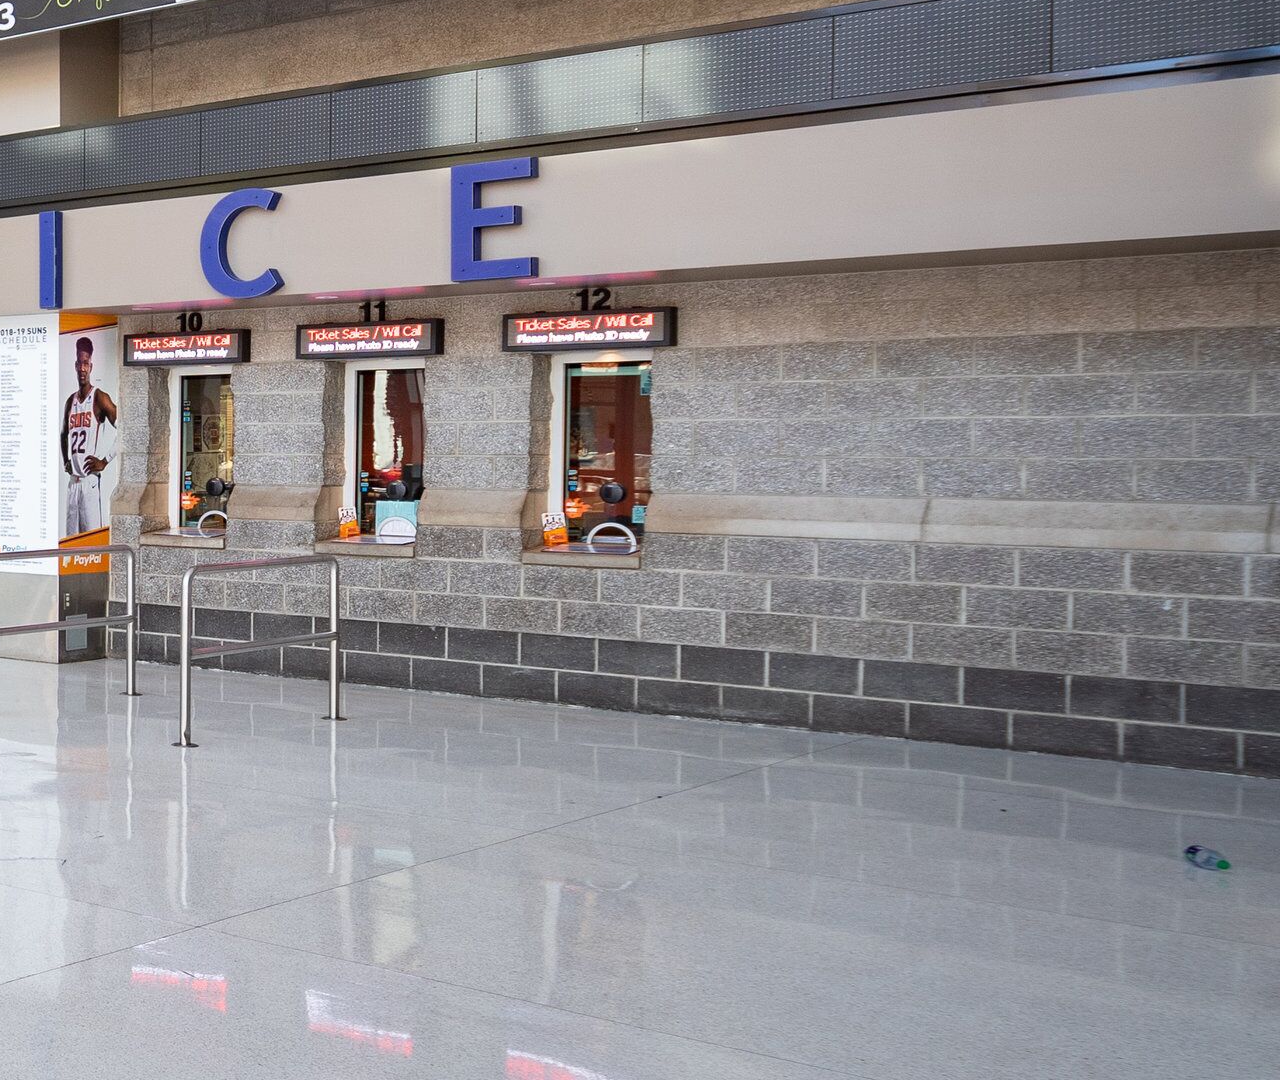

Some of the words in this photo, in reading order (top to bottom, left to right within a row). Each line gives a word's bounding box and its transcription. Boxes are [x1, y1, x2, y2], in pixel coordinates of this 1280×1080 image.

[576, 288, 612, 312] 12
[358, 300, 386, 322] 11
[27, 326, 48, 335] SUNS
[176, 311, 203, 333] 10
[516, 320, 554, 332] Ticket
[557, 317, 591, 330] Sales
[604, 314, 627, 327] Will
[630, 313, 654, 327] Call
[308, 329, 340, 341] Ticket
[342, 327, 369, 340] Sales
[382, 326, 400, 337] Will
[402, 324, 422, 336] Call
[69, 410, 92, 430] SUNS
[71, 431, 88, 454] 22
[73, 553, 102, 567] PayPal
